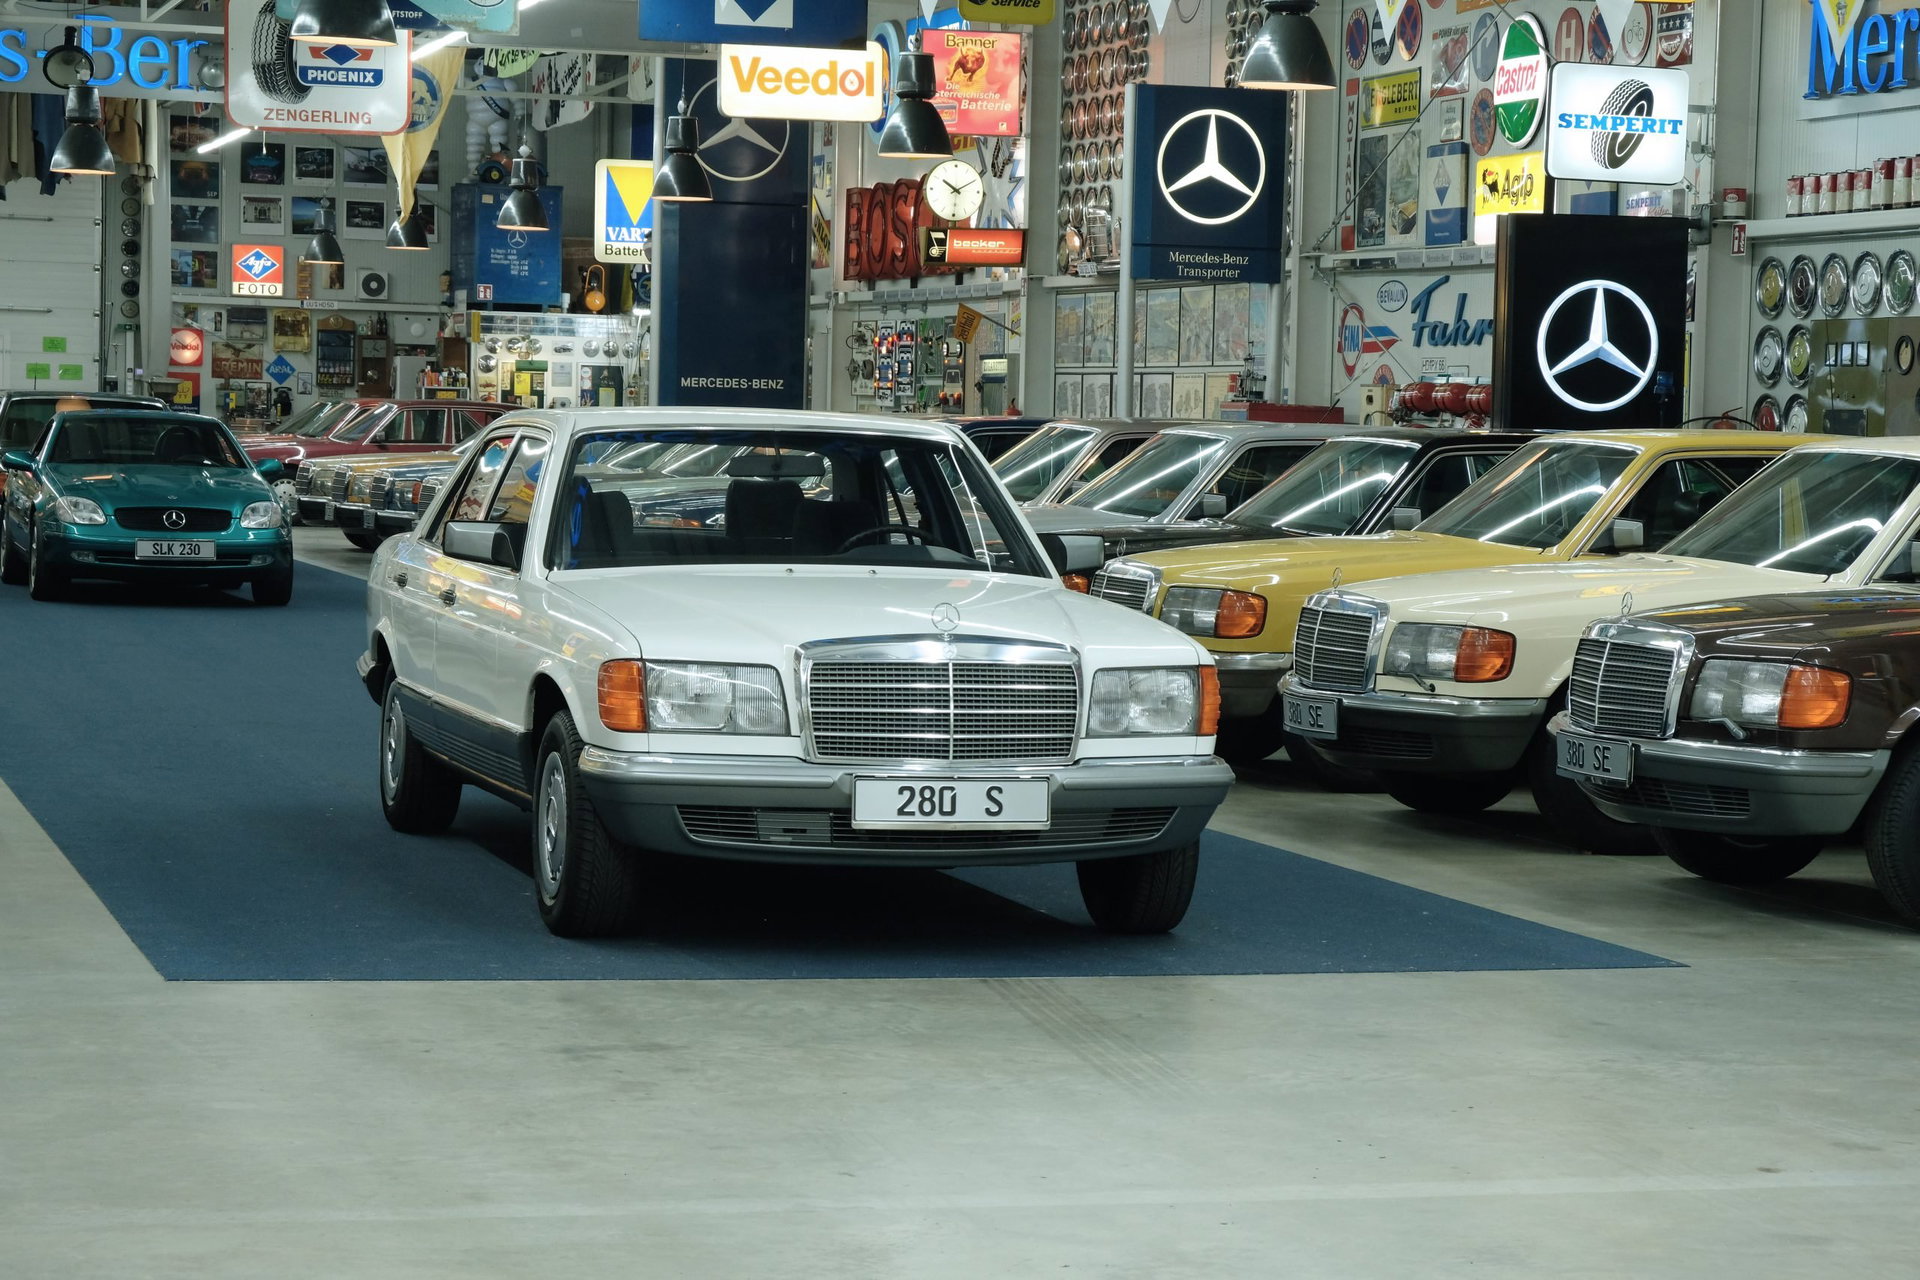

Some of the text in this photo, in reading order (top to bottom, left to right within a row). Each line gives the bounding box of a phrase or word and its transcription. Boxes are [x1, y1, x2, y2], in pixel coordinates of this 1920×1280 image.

[391, 11, 423, 19] FTSTOFF
[946, 33, 998, 49] Banner
[1803, 0, 1920, 99] Mer
[307, 69, 375, 84] PHOENIX
[730, 56, 874, 97] Veedol
[1496, 60, 1540, 97] Castrol
[946, 82, 960, 90] Die
[935, 90, 1001, 99] sterreichische
[960, 99, 1013, 112] Batterie
[263, 107, 372, 125] ZENGERLING
[1558, 113, 1683, 135] SEMPERIT
[1500, 167, 1534, 207] Agip
[607, 226, 653, 242] VART
[604, 243, 643, 257] Batter
[953, 239, 996, 248] becker
[241, 255, 272, 275] Agfa
[1169, 251, 1249, 265] Mercedes-Benz
[1177, 265, 1241, 279] Transporter
[238, 283, 278, 295] FOTO
[1411, 275, 1494, 348] Fahr
[1343, 325, 1360, 352] FINA
[269, 365, 293, 374] ARAL
[681, 376, 784, 391] MERCEDES-BENZ
[152, 543, 201, 556] SLK 230
[1288, 701, 1324, 728] 380 SE
[1566, 739, 1613, 773] 380 SE
[897, 786, 1003, 817] 280 S
